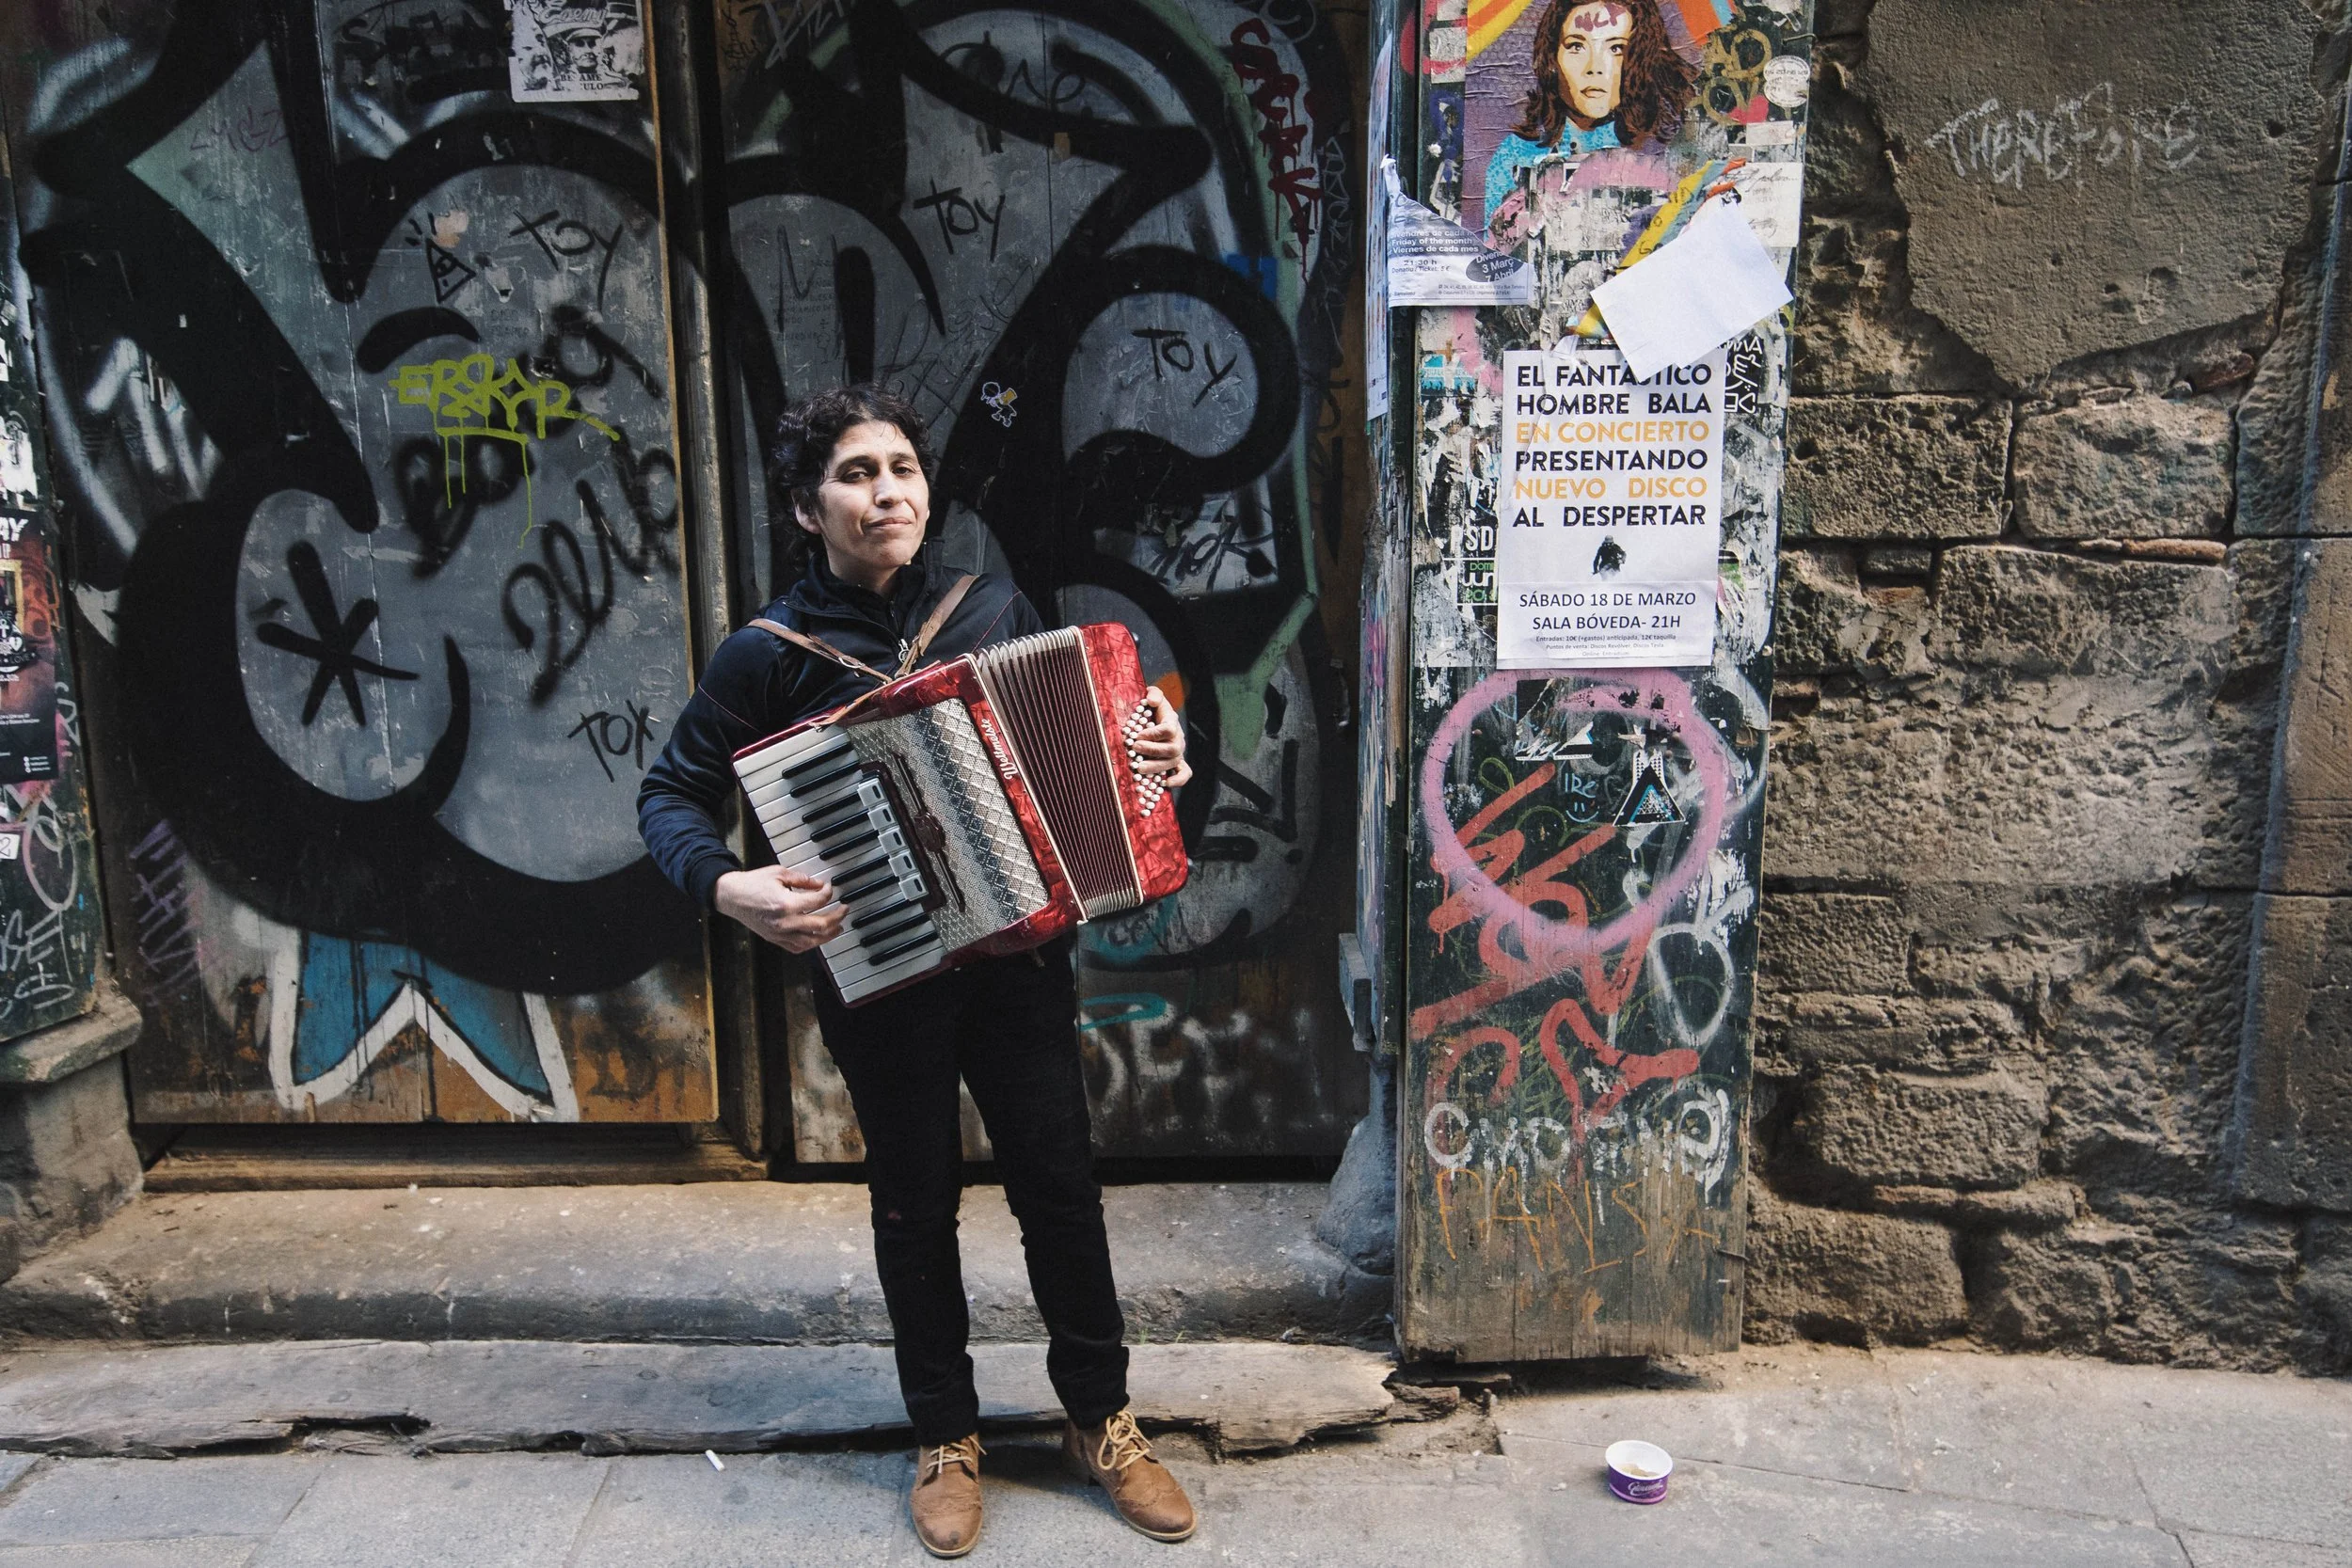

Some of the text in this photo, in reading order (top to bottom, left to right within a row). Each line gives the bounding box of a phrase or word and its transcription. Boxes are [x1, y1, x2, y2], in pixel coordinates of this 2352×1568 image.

[914, 175, 1006, 262] TOY
[508, 209, 623, 312] TOY
[1482, 257, 1515, 274] 3 Març
[1132, 327, 1237, 408] TOY
[1517, 363, 1712, 387] EL FANTÁTICO
[1517, 392, 1712, 416] HOMBRE BALA
[1516, 420, 1709, 444] EN CONCIERTO
[1516, 449, 1708, 471] PRESENTANDO
[1515, 477, 1708, 500] NUEVO DISCO
[1512, 504, 1707, 528] AL DESPERTAR
[1518, 590, 1697, 608] SÁBADO 18 DE MARZO
[1533, 616, 1572, 630] SALA
[1651, 615, 1681, 628] 21H
